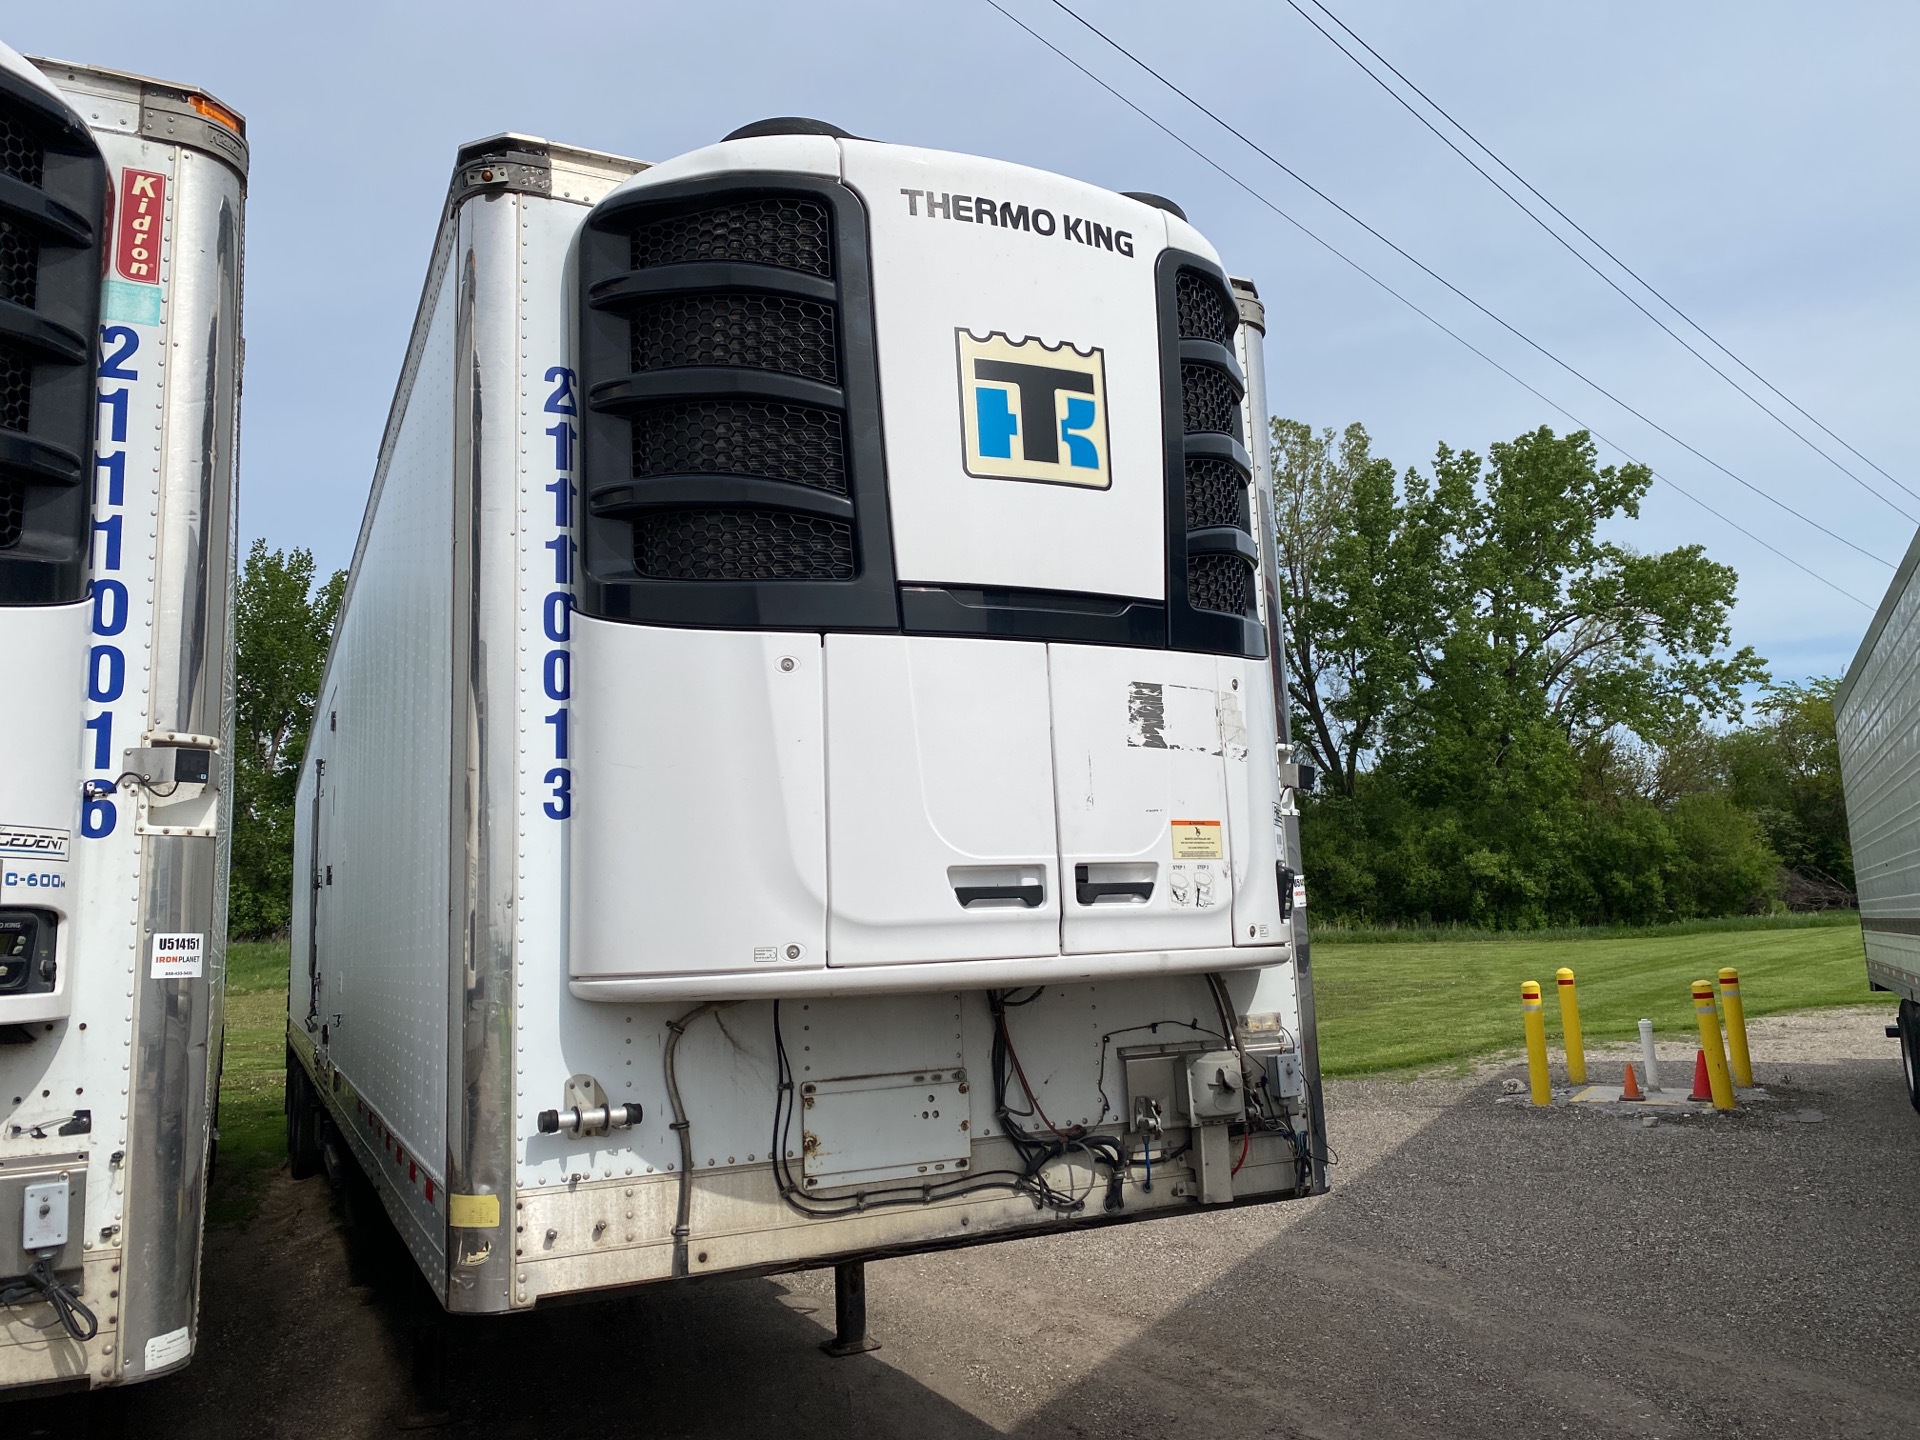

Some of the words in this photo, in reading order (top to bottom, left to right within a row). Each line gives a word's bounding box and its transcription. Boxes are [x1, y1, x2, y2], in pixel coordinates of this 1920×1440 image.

[129, 175, 157, 276] Kidron
[900, 188, 1056, 237] THERMO
[1063, 214, 1134, 258] KING
[159, 937, 200, 950] U514151
